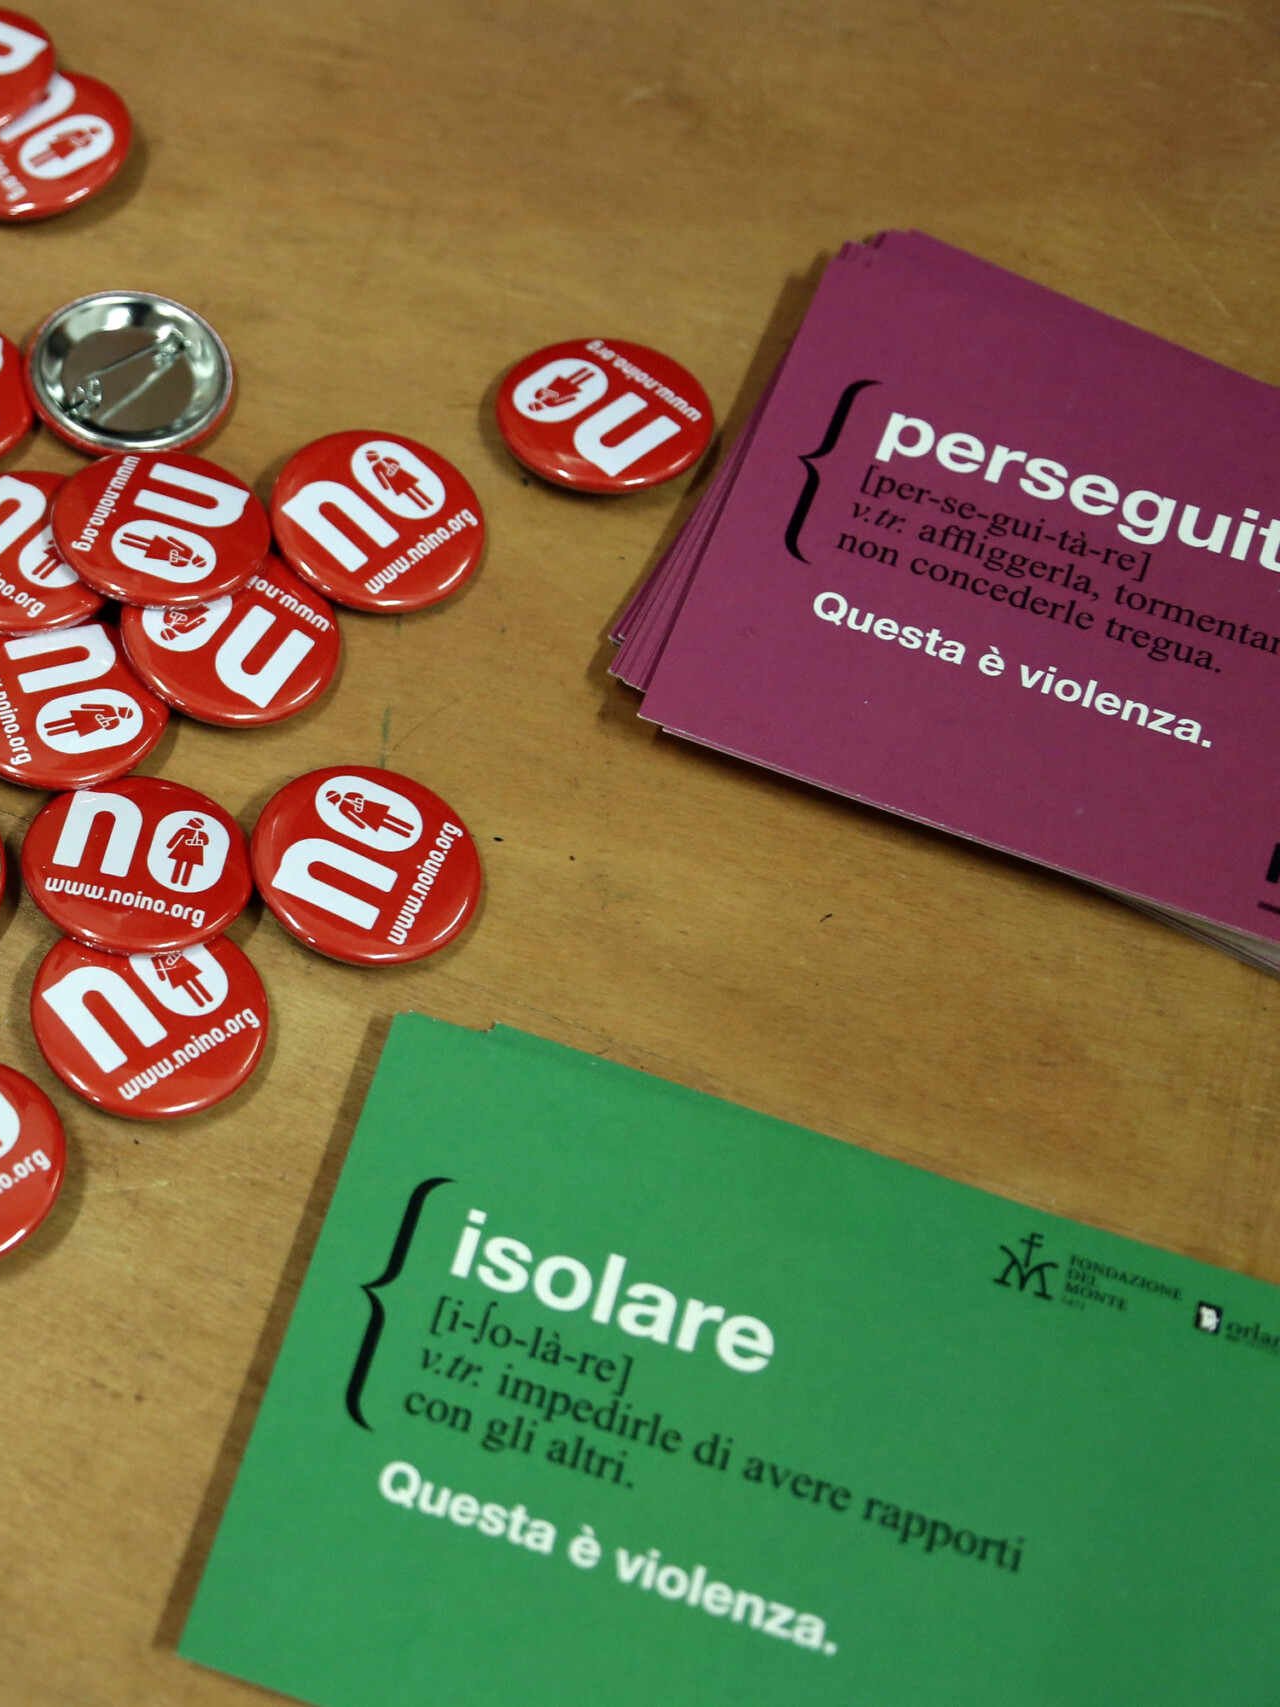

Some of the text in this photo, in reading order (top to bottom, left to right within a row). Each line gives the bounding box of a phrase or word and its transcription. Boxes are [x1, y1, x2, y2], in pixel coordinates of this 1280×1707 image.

[512, 358, 681, 477] no
[585, 339, 702, 422] www.noino.org
[71, 455, 141, 552] www.noino.org
[111, 462, 250, 583] no
[281, 440, 446, 572] no
[364, 508, 478, 594] www.noino.org
[874, 411, 1280, 573] perseguit
[836, 532, 1221, 673] non concederle tregua.
[852, 501, 1280, 655] v.tr. affliggerla, tormentar
[4, 623, 144, 755] no
[813, 591, 1213, 748] Questa è violenza.
[45, 877, 205, 928] www.noino.org
[52, 790, 230, 893] no
[271, 775, 423, 930] no
[387, 822, 463, 946] www.noino.org
[117, 1008, 260, 1100] www.noino.org
[450, 1208, 775, 1374] isolare
[403, 1391, 634, 1489] con gli altri.
[420, 1348, 1026, 1575] v.tr. impedirle di avere rapporti
[378, 1460, 837, 1656] Questa è violenza.
